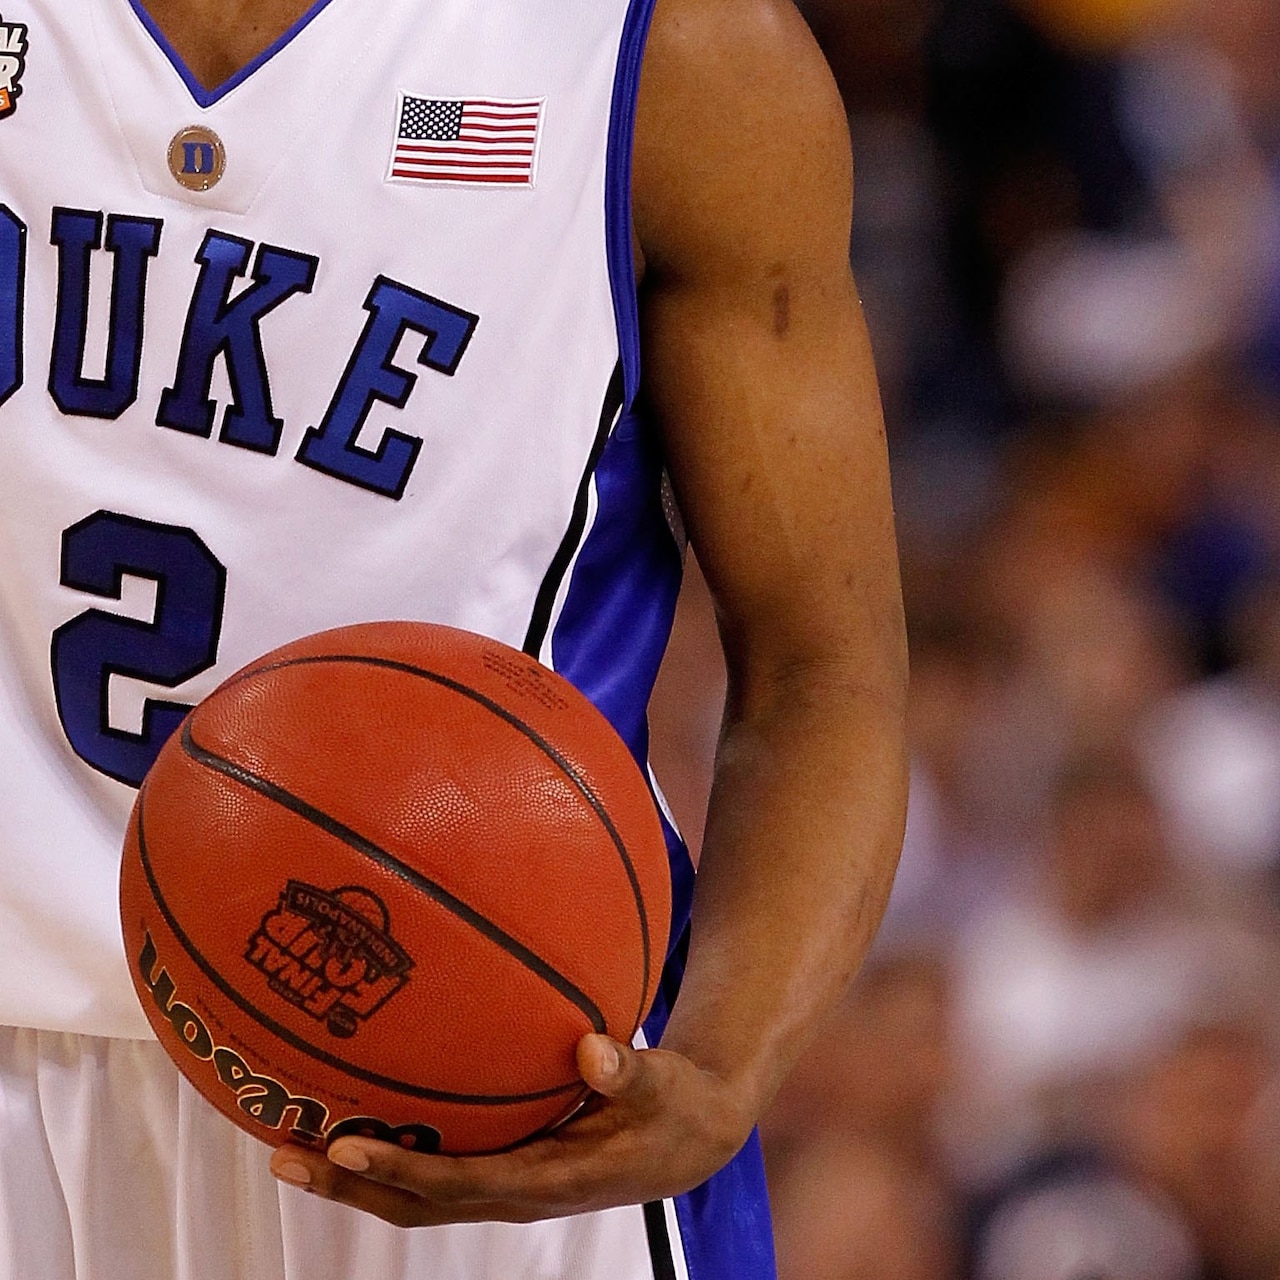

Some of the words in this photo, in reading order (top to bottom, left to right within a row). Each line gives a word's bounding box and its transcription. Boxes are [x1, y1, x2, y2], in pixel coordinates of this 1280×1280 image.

[182, 142, 214, 174] D
[50, 509, 227, 791] 2
[250, 935, 341, 1013] FINAL
